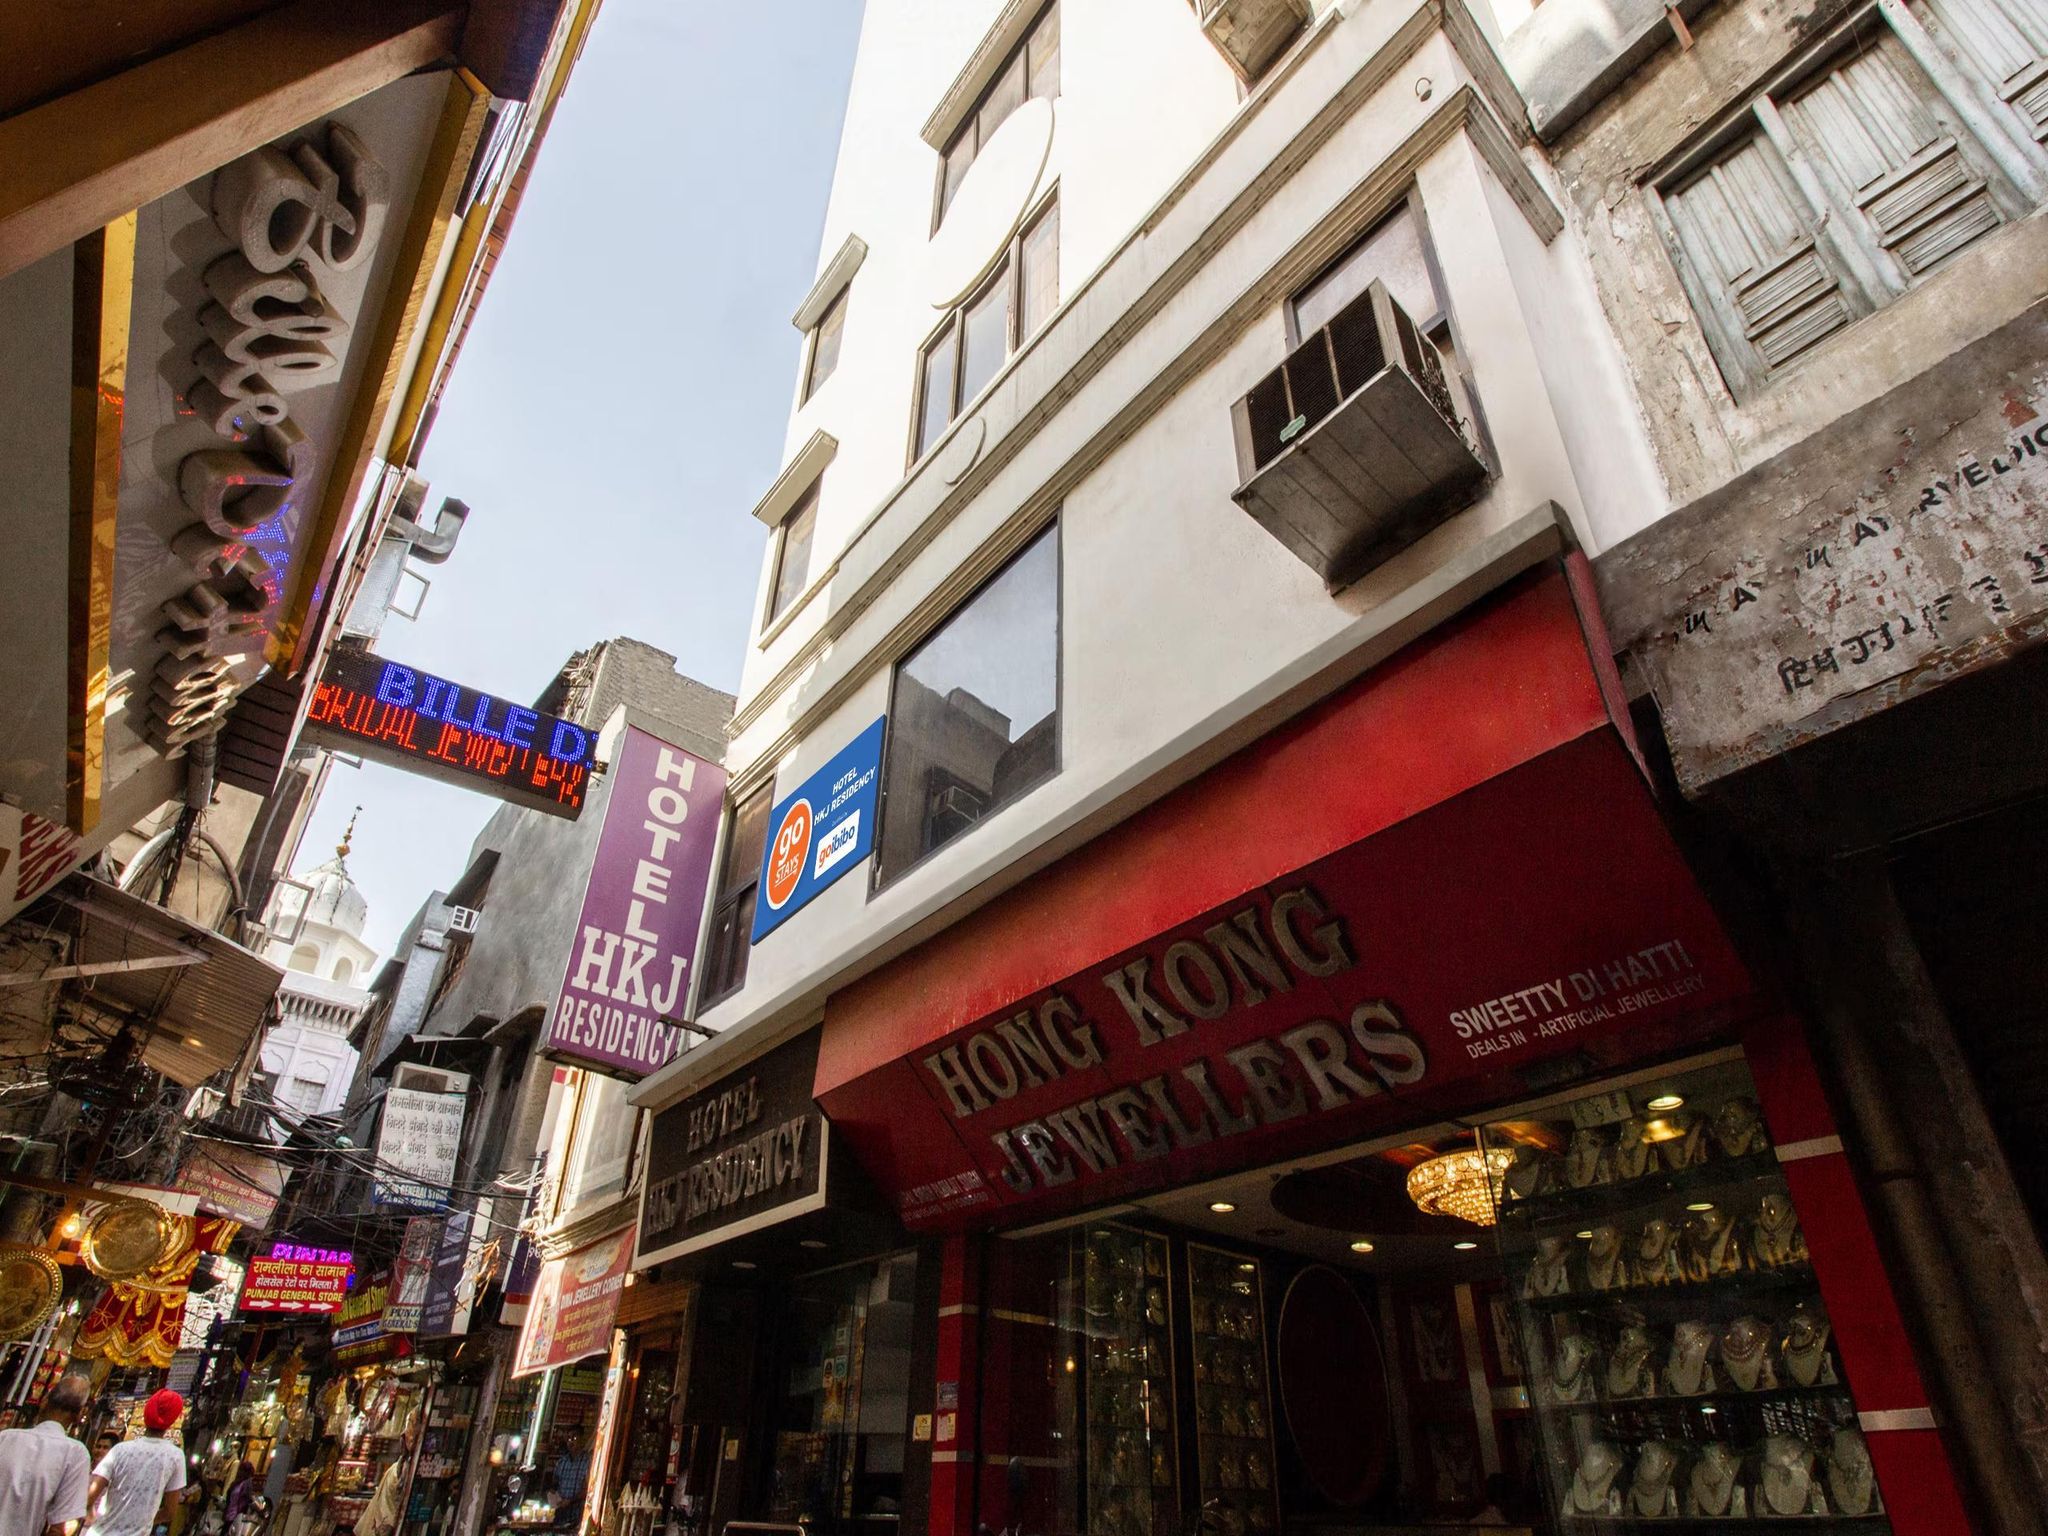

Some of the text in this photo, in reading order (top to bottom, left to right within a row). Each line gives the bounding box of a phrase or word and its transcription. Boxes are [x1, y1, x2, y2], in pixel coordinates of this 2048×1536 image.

[377, 662, 538, 749] BILLE
[813, 804, 830, 826] HKJ
[830, 766, 876, 813] RESIDENCY
[832, 767, 858, 795] HOTEL
[625, 747, 697, 944] HOTEL
[775, 852, 800, 884] STAYS
[778, 815, 805, 866] go
[818, 824, 856, 869] goibibo
[570, 925, 688, 1015] HKJ
[923, 887, 1356, 1119] HONG KONG
[1449, 938, 1694, 1039] SWEETTY DI HATTI
[554, 995, 679, 1067] RESIDENCY
[1466, 1033, 1511, 1059] DEALS
[1511, 1029, 1527, 1047] IN
[1615, 972, 1705, 1014] JEWELLERY
[687, 1075, 760, 1153] HOTEL
[991, 999, 1428, 1194] JEWELLERS
[245, 1288, 343, 1302] PUNJAB GENERAL STORE
[253, 1259, 347, 1278] रामलीला का सामान
[308, 1277, 331, 1290] मिलता
[333, 1278, 339, 1291] है
